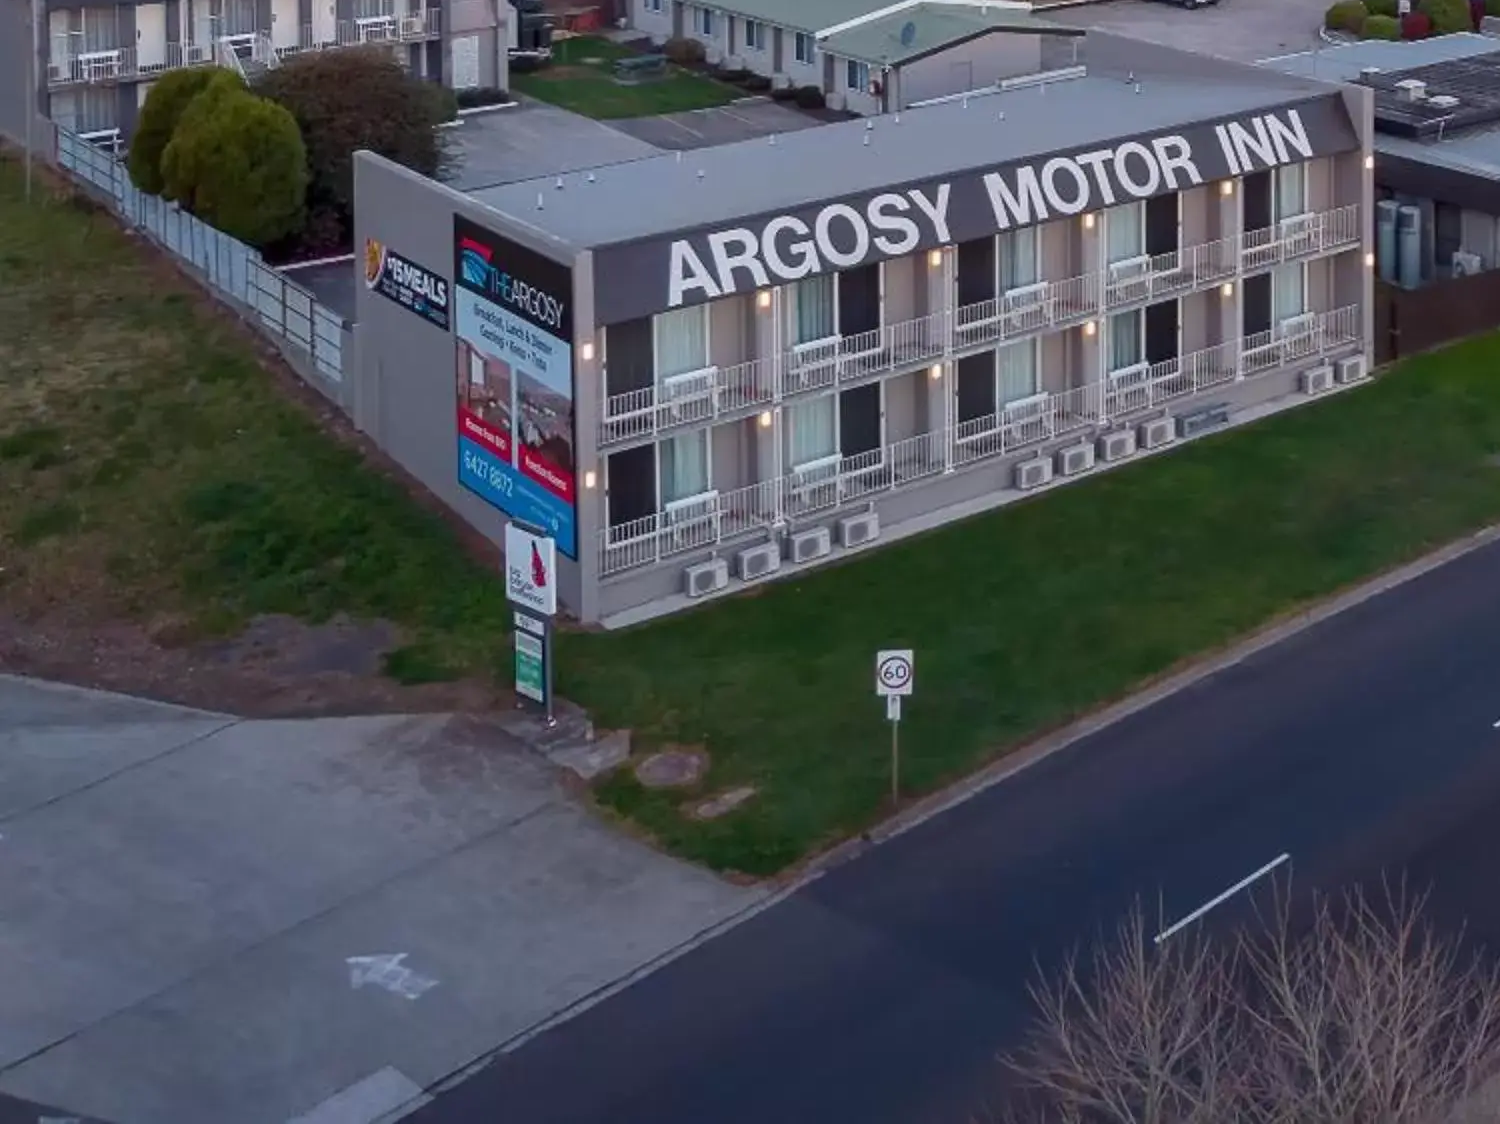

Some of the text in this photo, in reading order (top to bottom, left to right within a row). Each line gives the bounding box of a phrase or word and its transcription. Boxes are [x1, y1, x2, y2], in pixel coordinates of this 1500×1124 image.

[667, 109, 1313, 307] ARGOSY MOTOR INN
[511, 279, 564, 328] ARGOSY
[884, 665, 906, 680] 60
